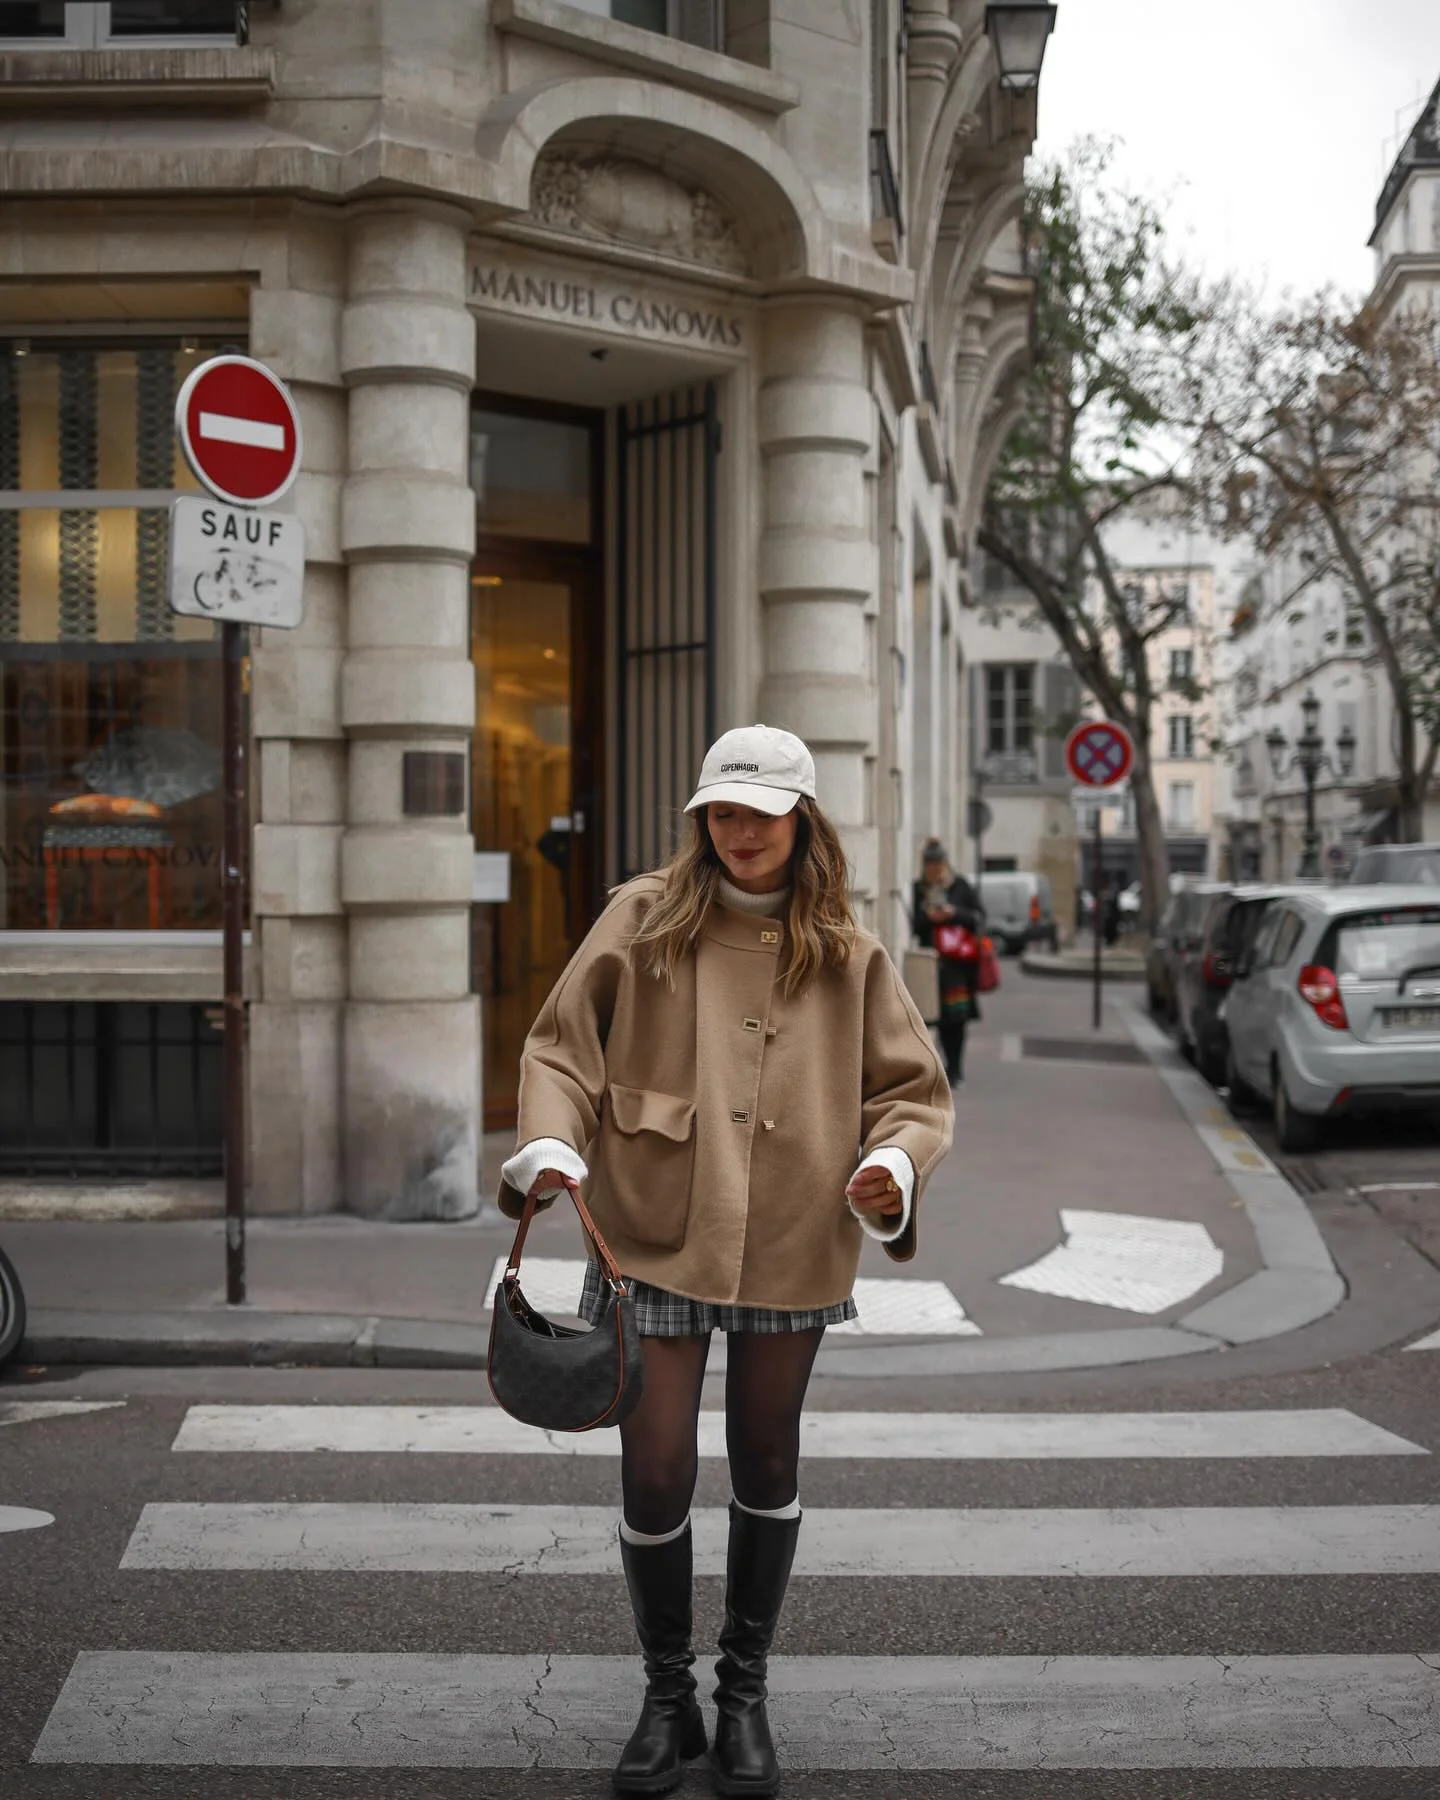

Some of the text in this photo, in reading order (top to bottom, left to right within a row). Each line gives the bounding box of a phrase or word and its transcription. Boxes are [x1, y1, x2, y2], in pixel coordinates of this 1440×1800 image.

[471, 266, 743, 347] MANUEL CANOVAS
[201, 509, 283, 547] SAUF
[720, 763, 760, 773] COPENHAGEN
[101, 843, 222, 868] CANOV
